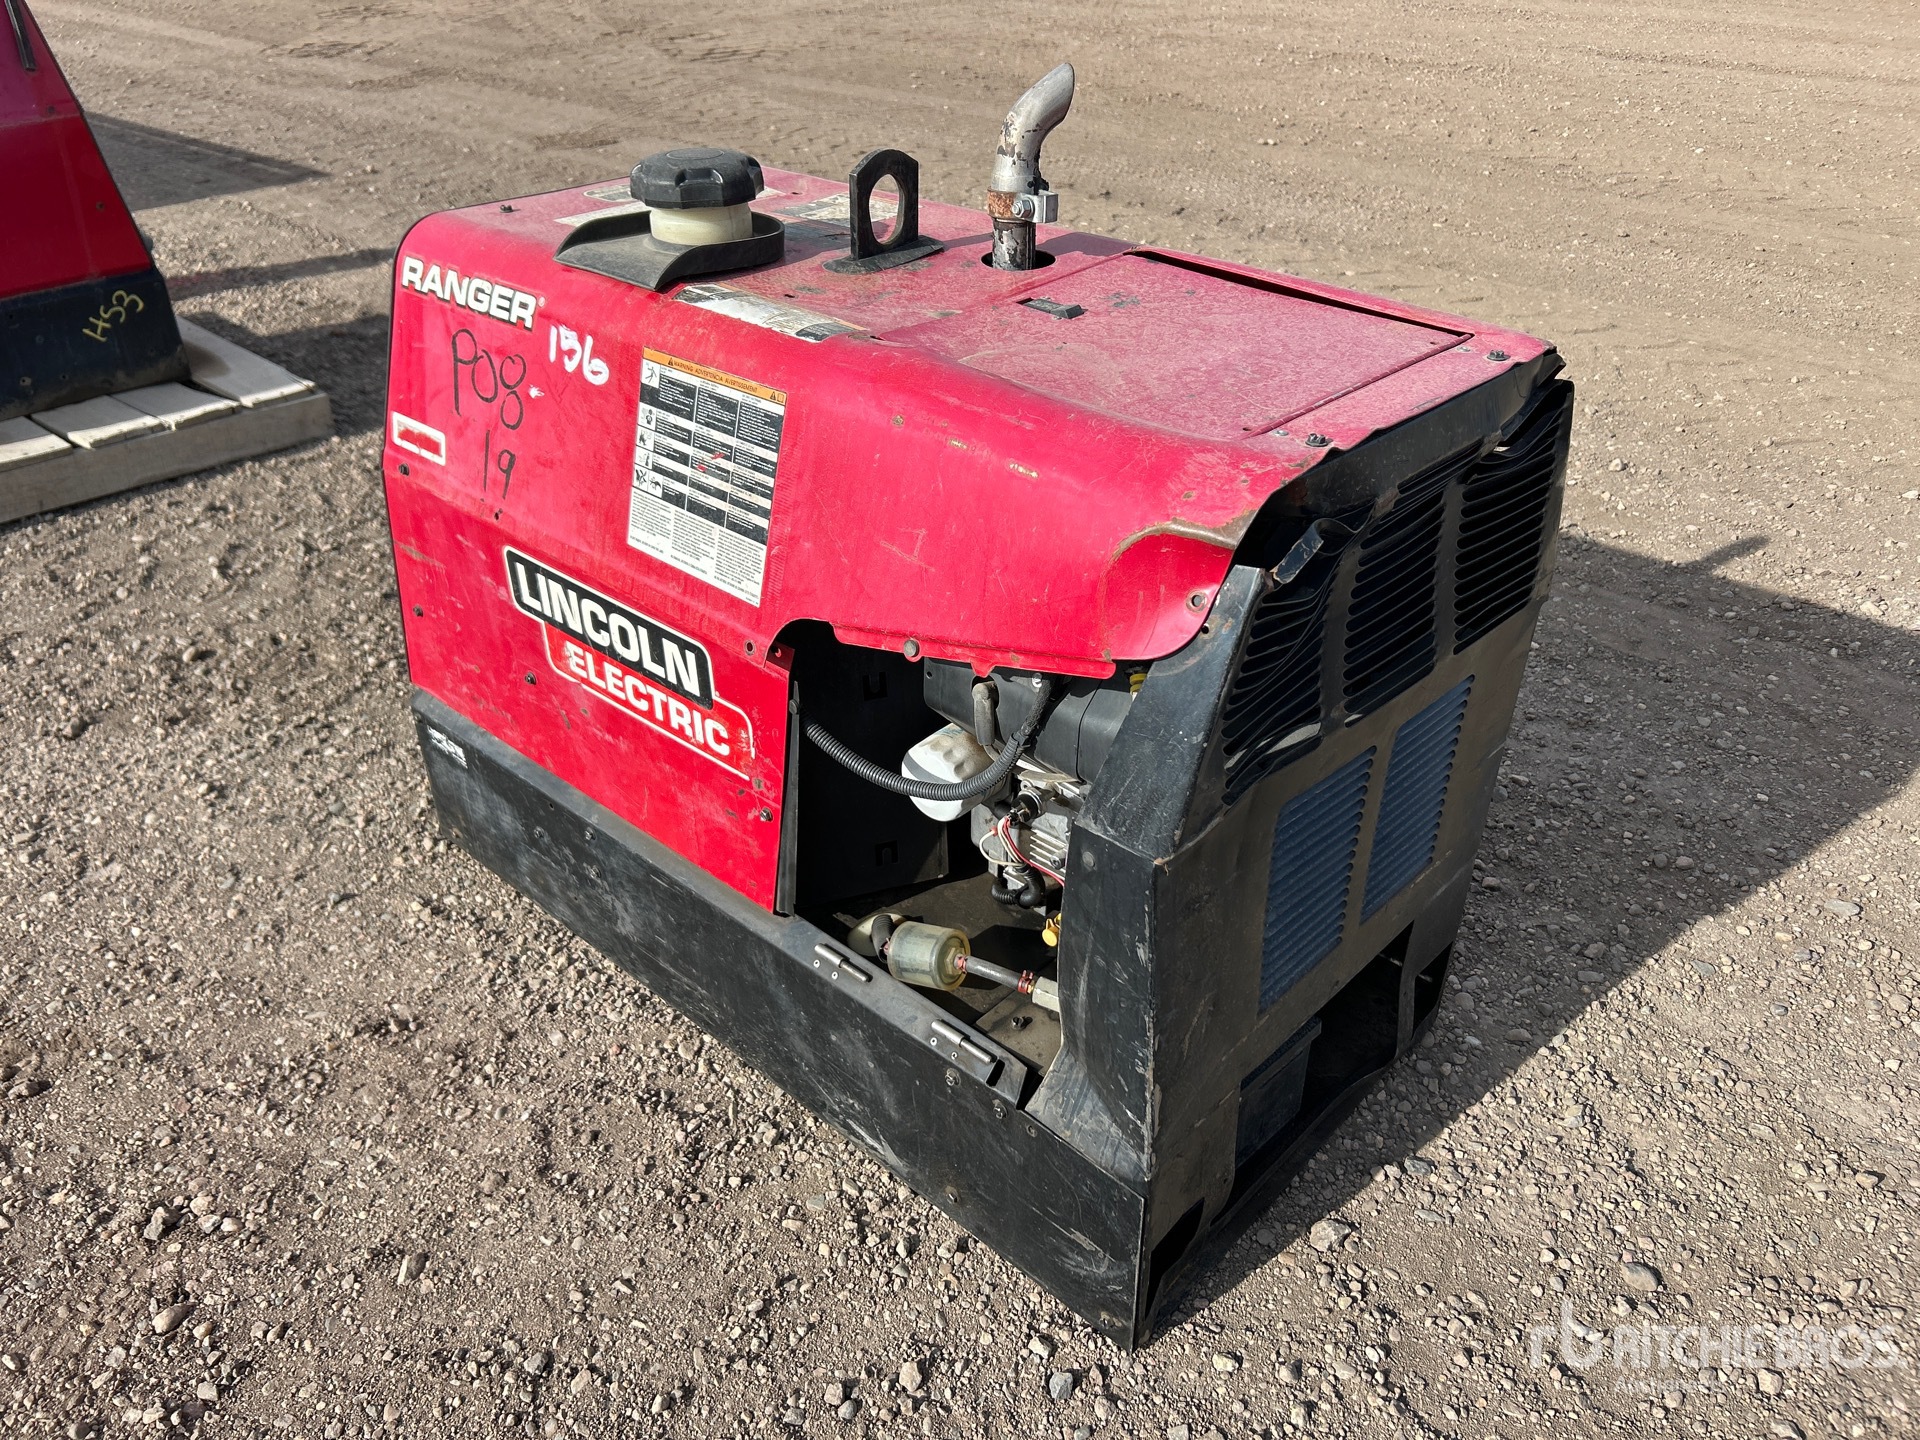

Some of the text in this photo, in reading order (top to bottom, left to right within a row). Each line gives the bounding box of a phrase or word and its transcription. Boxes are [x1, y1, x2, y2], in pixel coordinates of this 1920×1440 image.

[549, 324, 610, 386] 156
[673, 359, 694, 373] WARNING
[514, 561, 700, 698] LINCOLN
[565, 639, 730, 757] ELECTRIC
